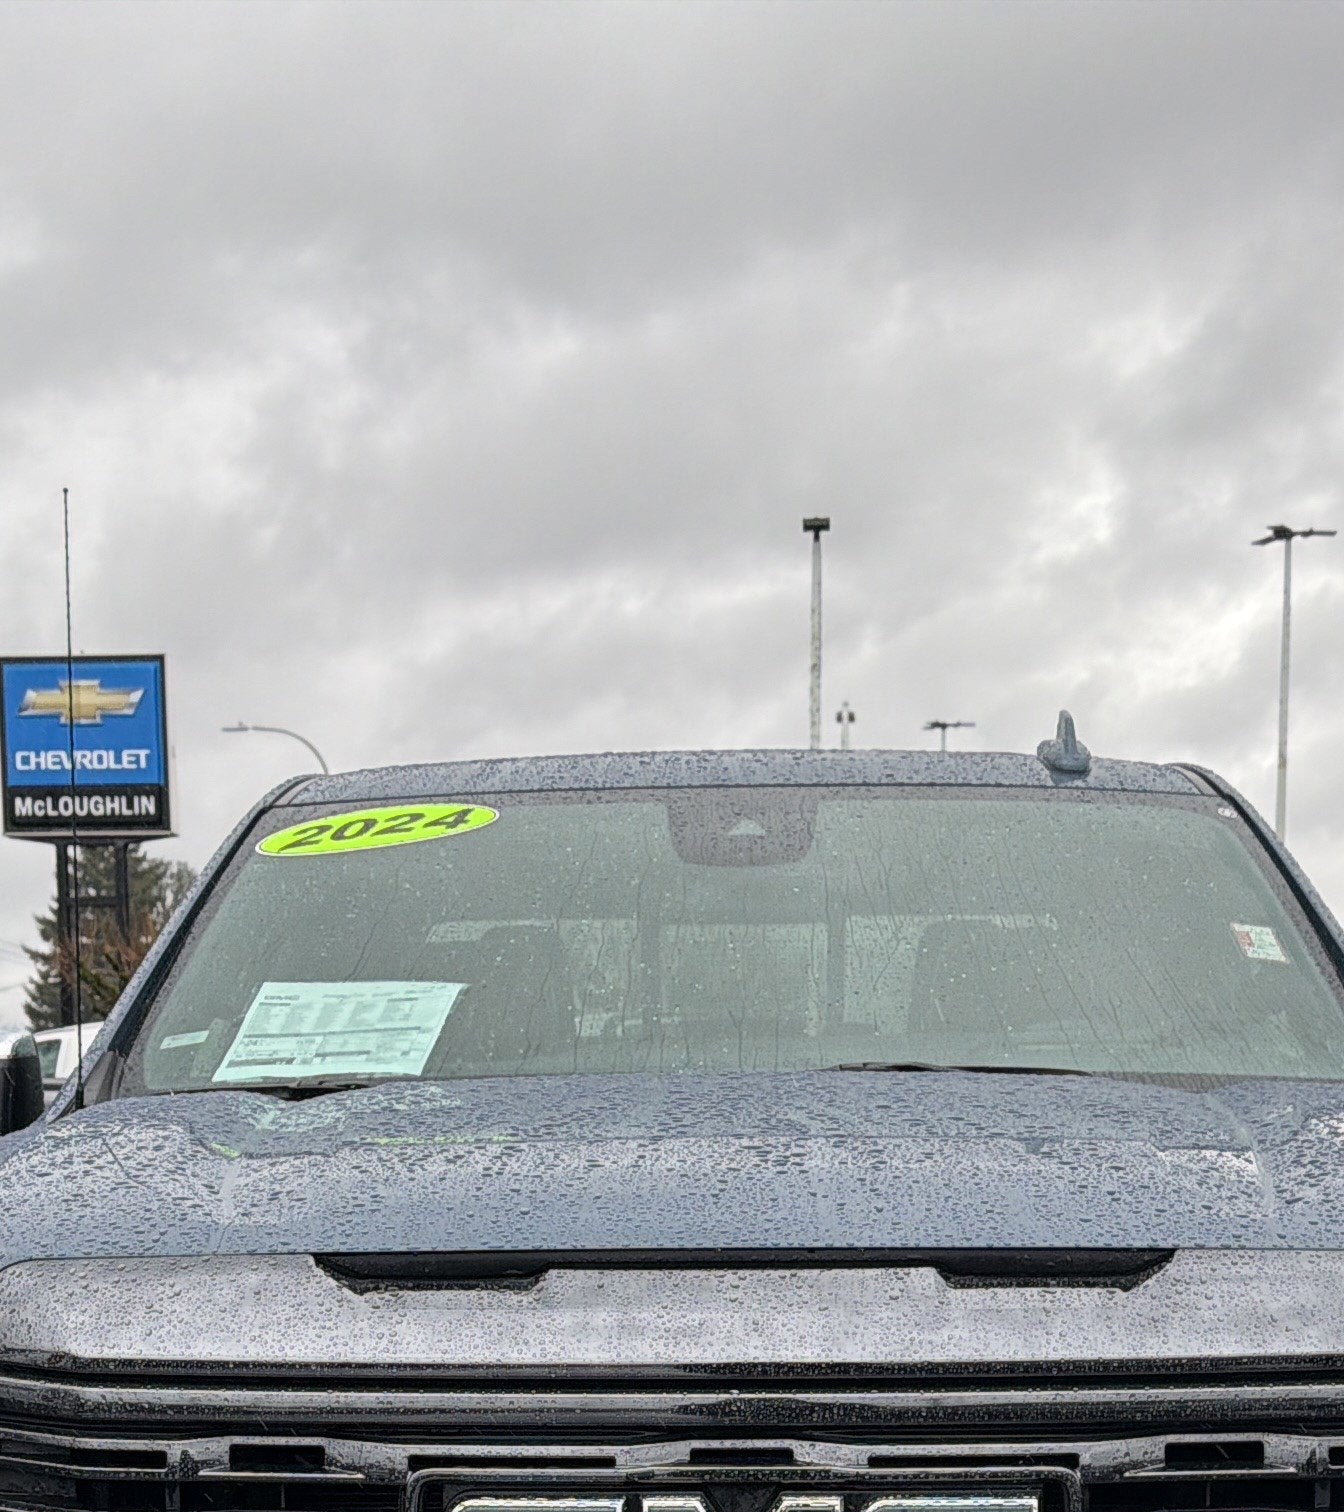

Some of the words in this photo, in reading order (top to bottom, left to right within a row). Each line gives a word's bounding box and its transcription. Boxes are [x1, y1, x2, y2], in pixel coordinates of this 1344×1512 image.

[15, 749, 150, 771] CHEVROLET
[14, 794, 156, 817] McLOUGHLIN
[278, 808, 475, 854] 2024
